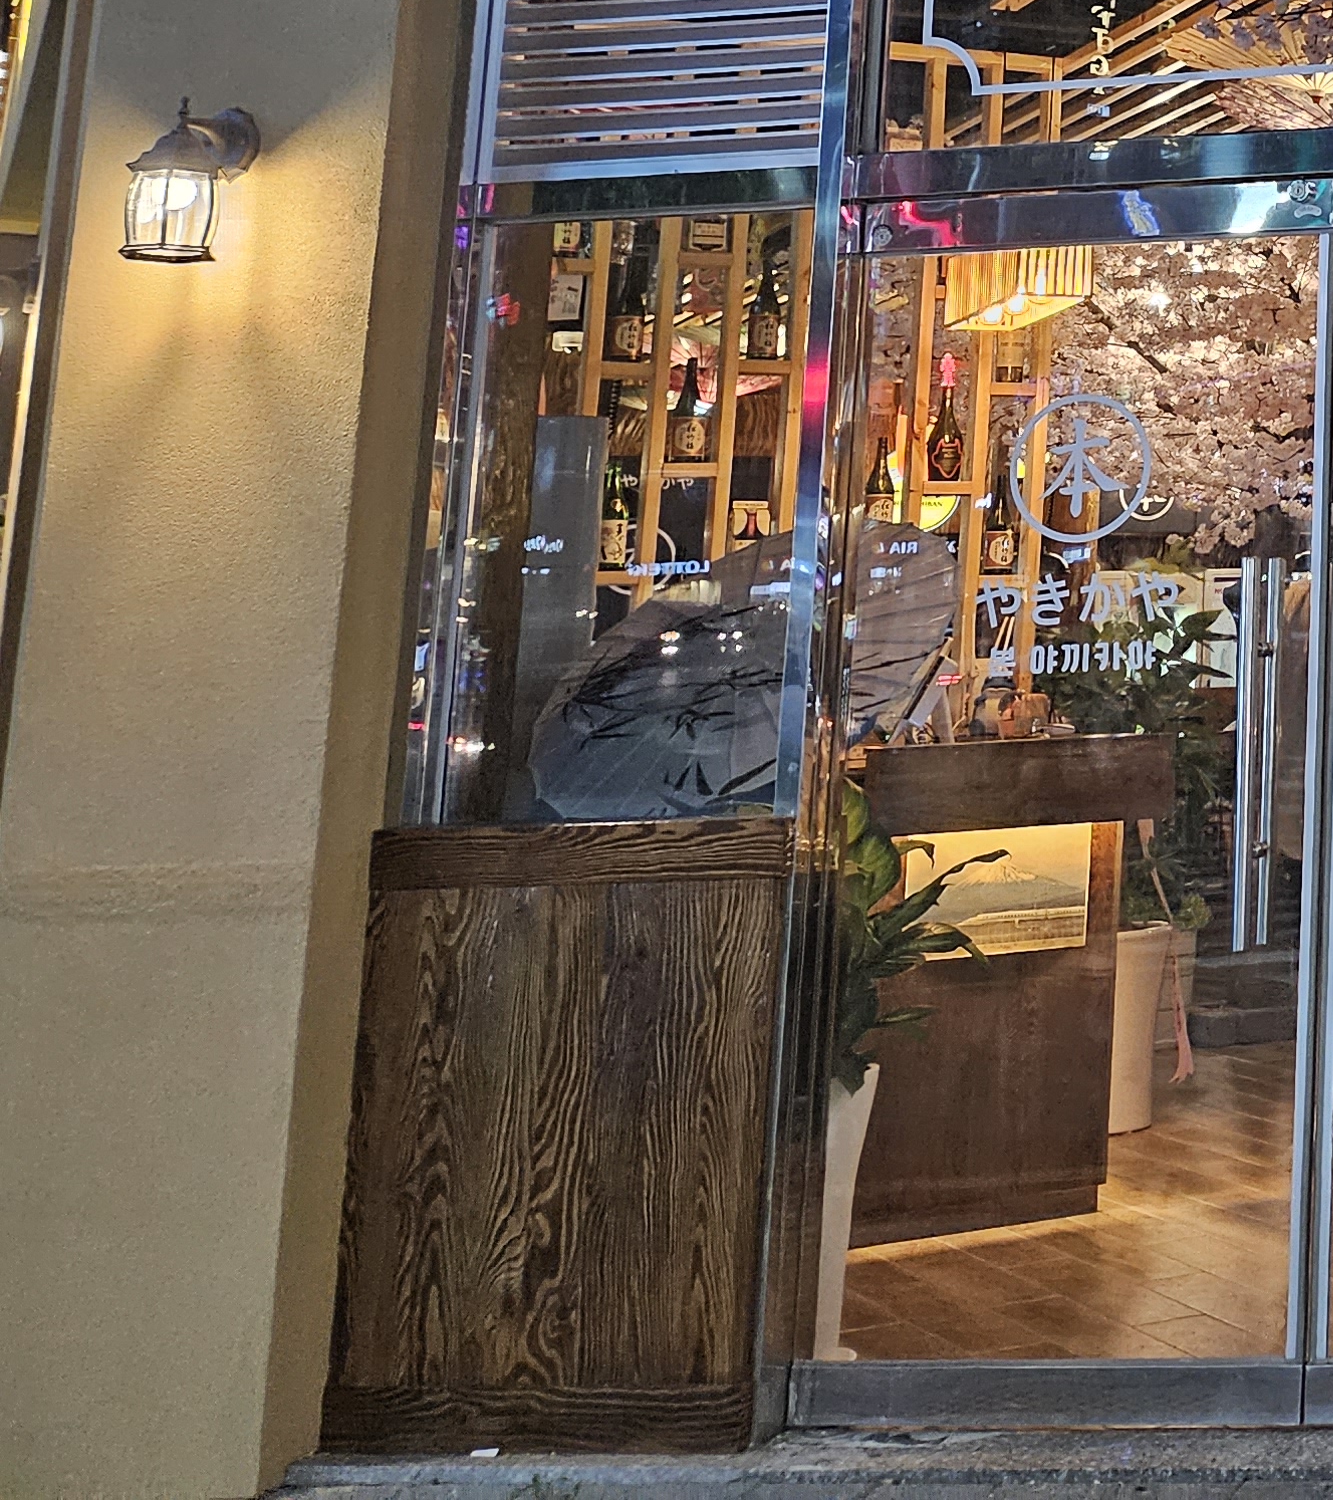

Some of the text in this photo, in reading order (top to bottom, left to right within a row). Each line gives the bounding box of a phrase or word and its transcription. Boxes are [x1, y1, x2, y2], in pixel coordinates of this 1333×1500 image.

[1041, 418, 1130, 518] 本
[975, 571, 1180, 629] やきかや
[988, 638, 1158, 679] 본 야끼카야
